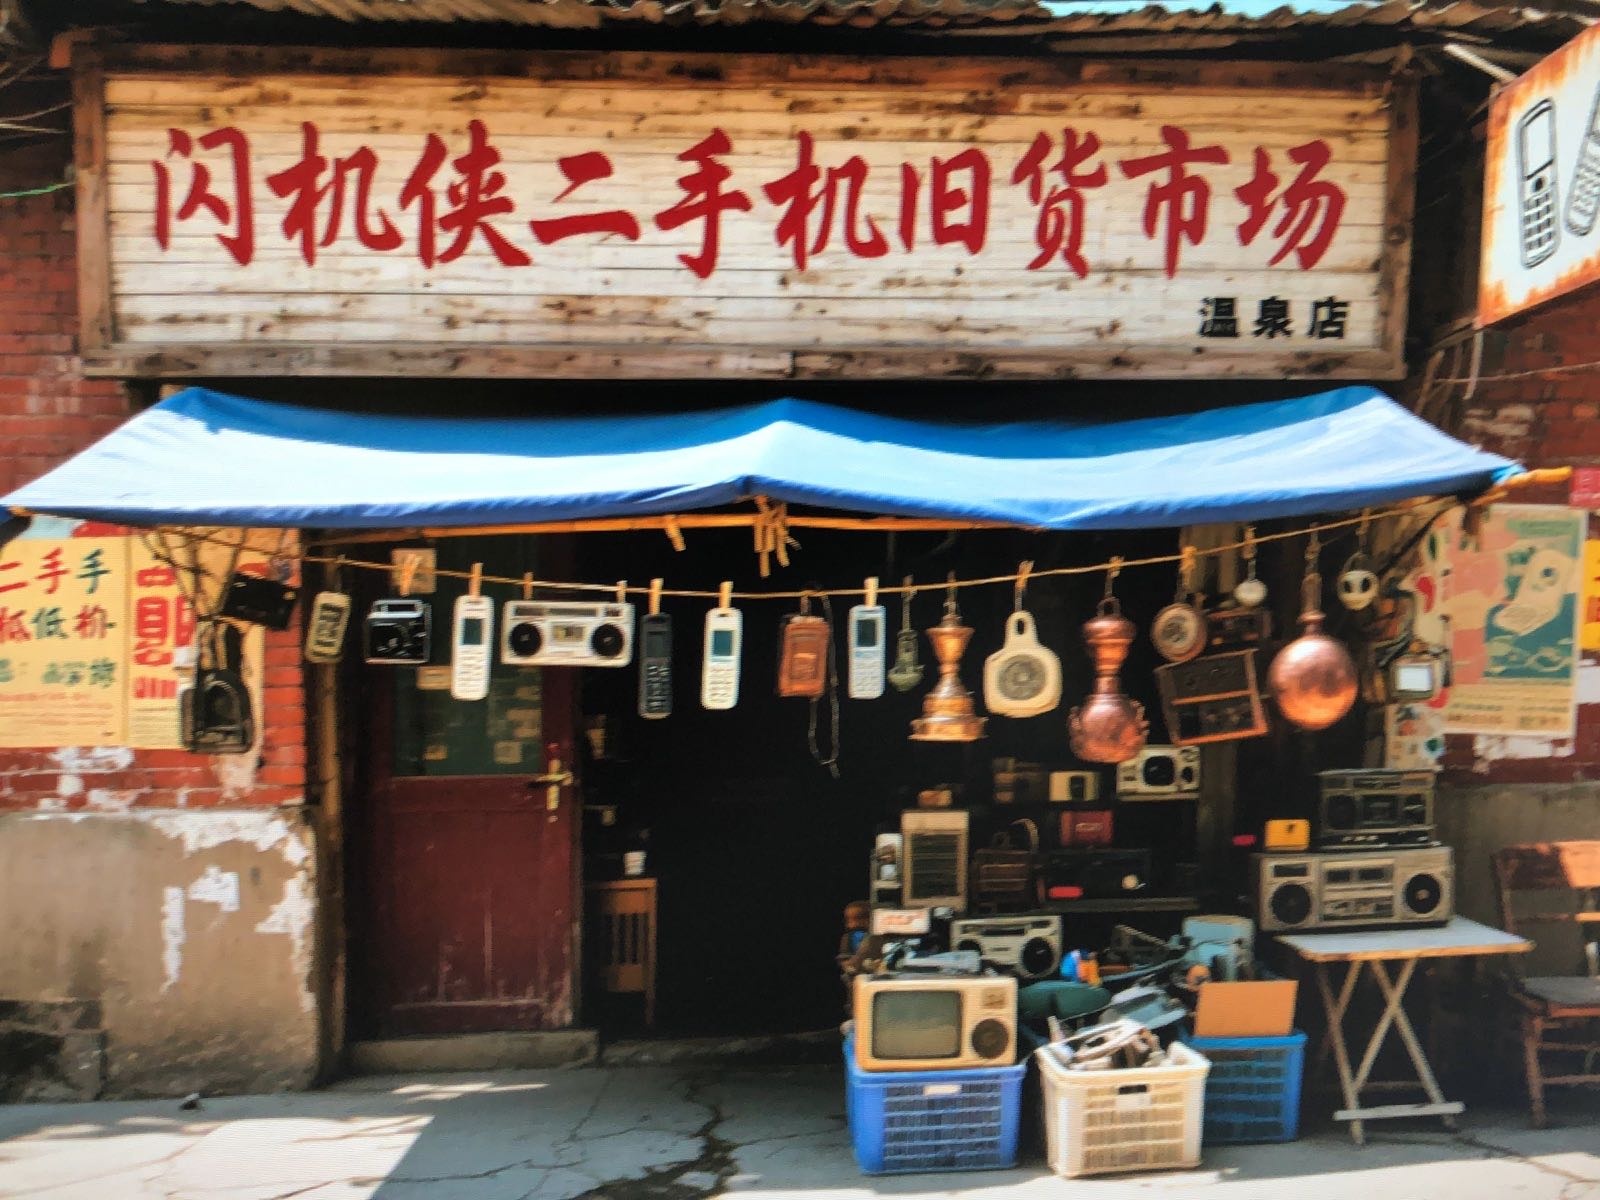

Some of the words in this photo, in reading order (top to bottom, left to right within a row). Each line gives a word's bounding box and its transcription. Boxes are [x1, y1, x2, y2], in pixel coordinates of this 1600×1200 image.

[153, 119, 1346, 279] 闪机侠二手机旧货市场
